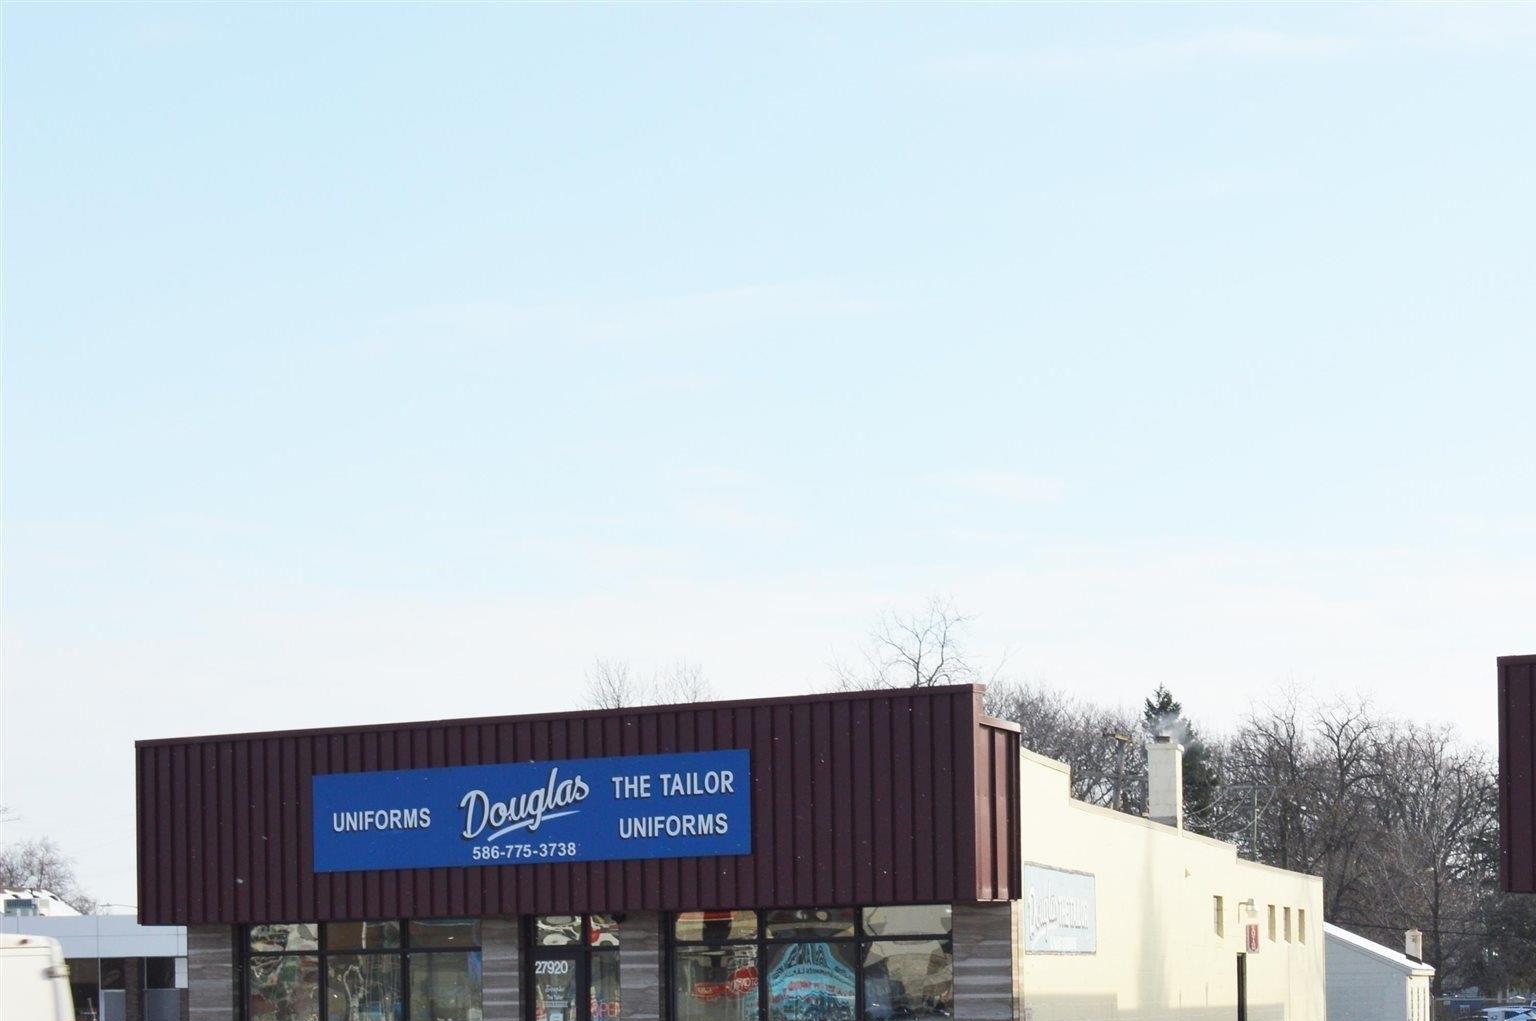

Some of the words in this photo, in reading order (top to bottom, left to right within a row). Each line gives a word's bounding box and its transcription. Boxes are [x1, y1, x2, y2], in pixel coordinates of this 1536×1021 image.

[612, 775, 651, 799] THE
[660, 770, 735, 796] TAILOR
[460, 767, 590, 838] Douglas
[333, 807, 432, 832] UNIFORMS
[619, 812, 729, 839] UNIFORMS
[472, 842, 577, 860] 586-775-3738
[535, 960, 569, 974] 27920
